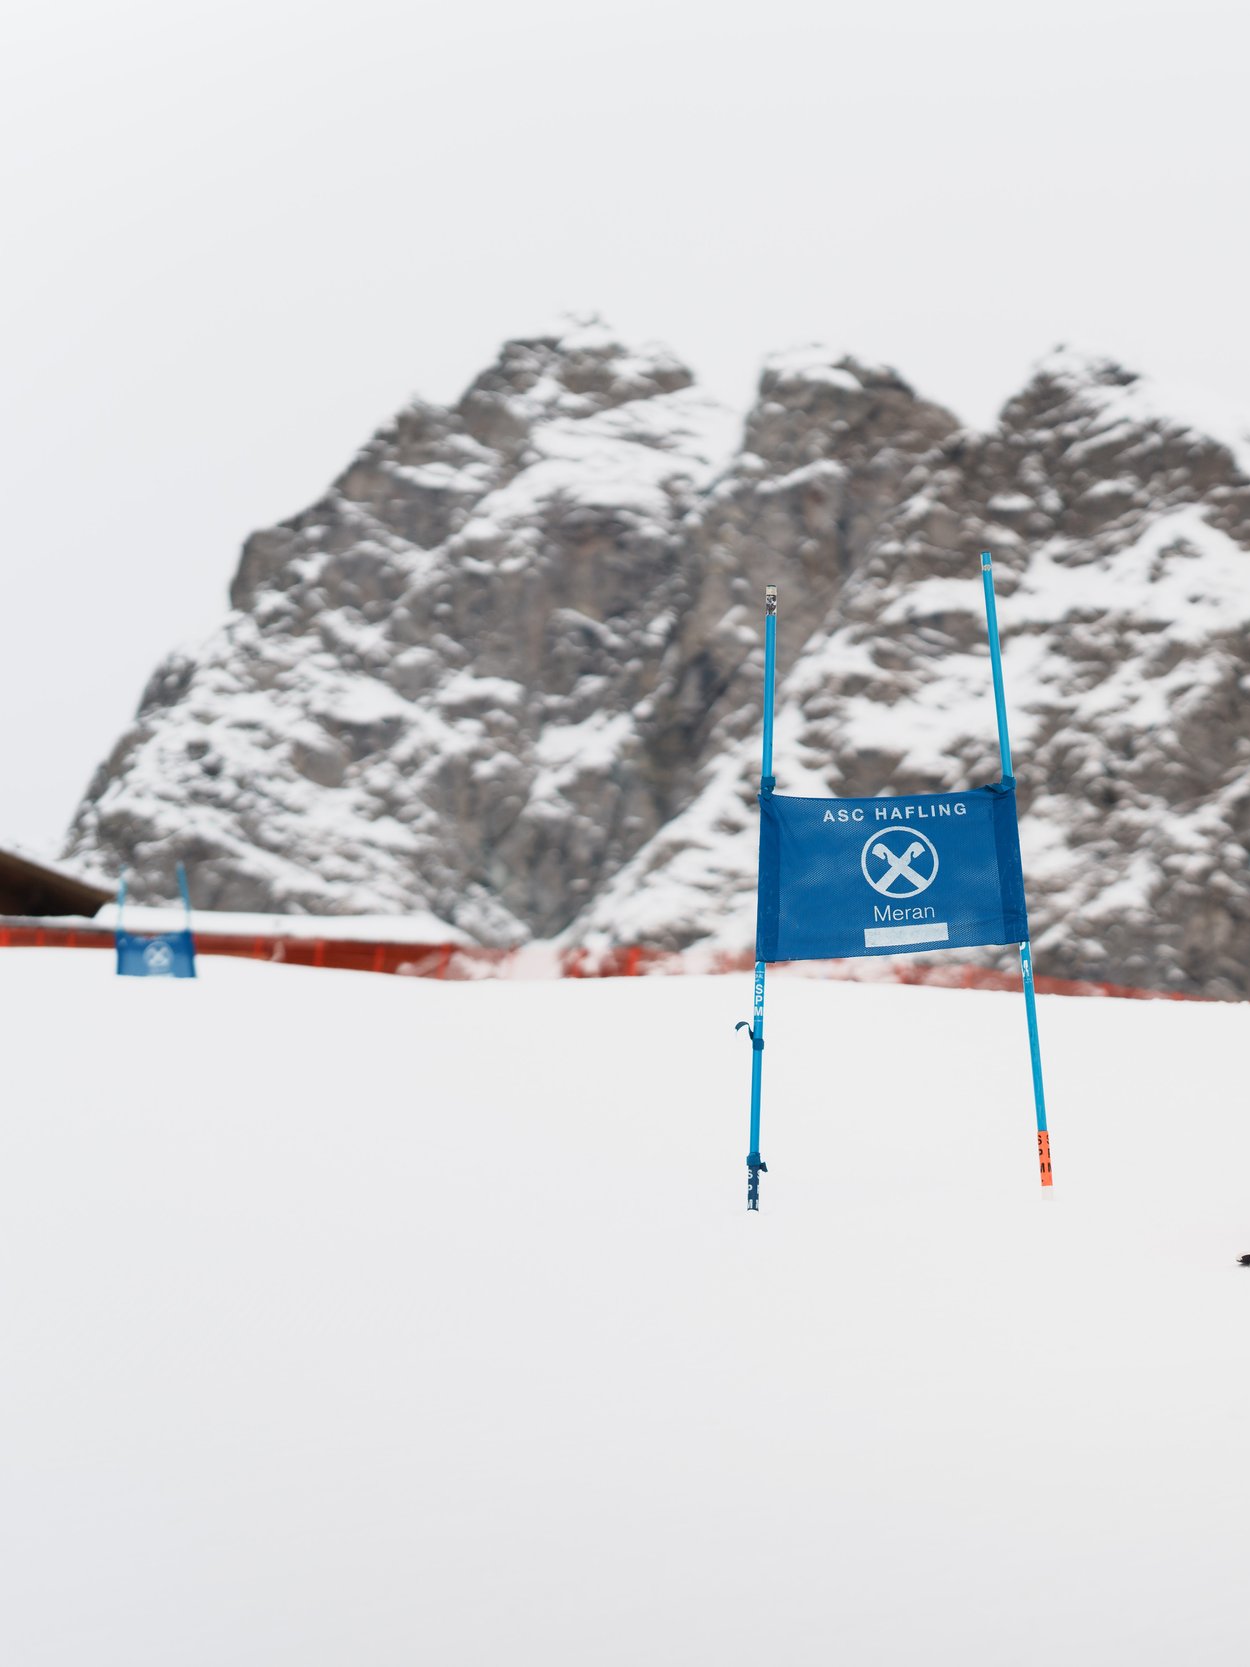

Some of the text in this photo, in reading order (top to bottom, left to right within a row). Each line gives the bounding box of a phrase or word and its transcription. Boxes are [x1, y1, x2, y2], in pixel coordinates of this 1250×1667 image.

[823, 802, 967, 822] ASC HAFLING
[873, 904, 935, 922] Meran
